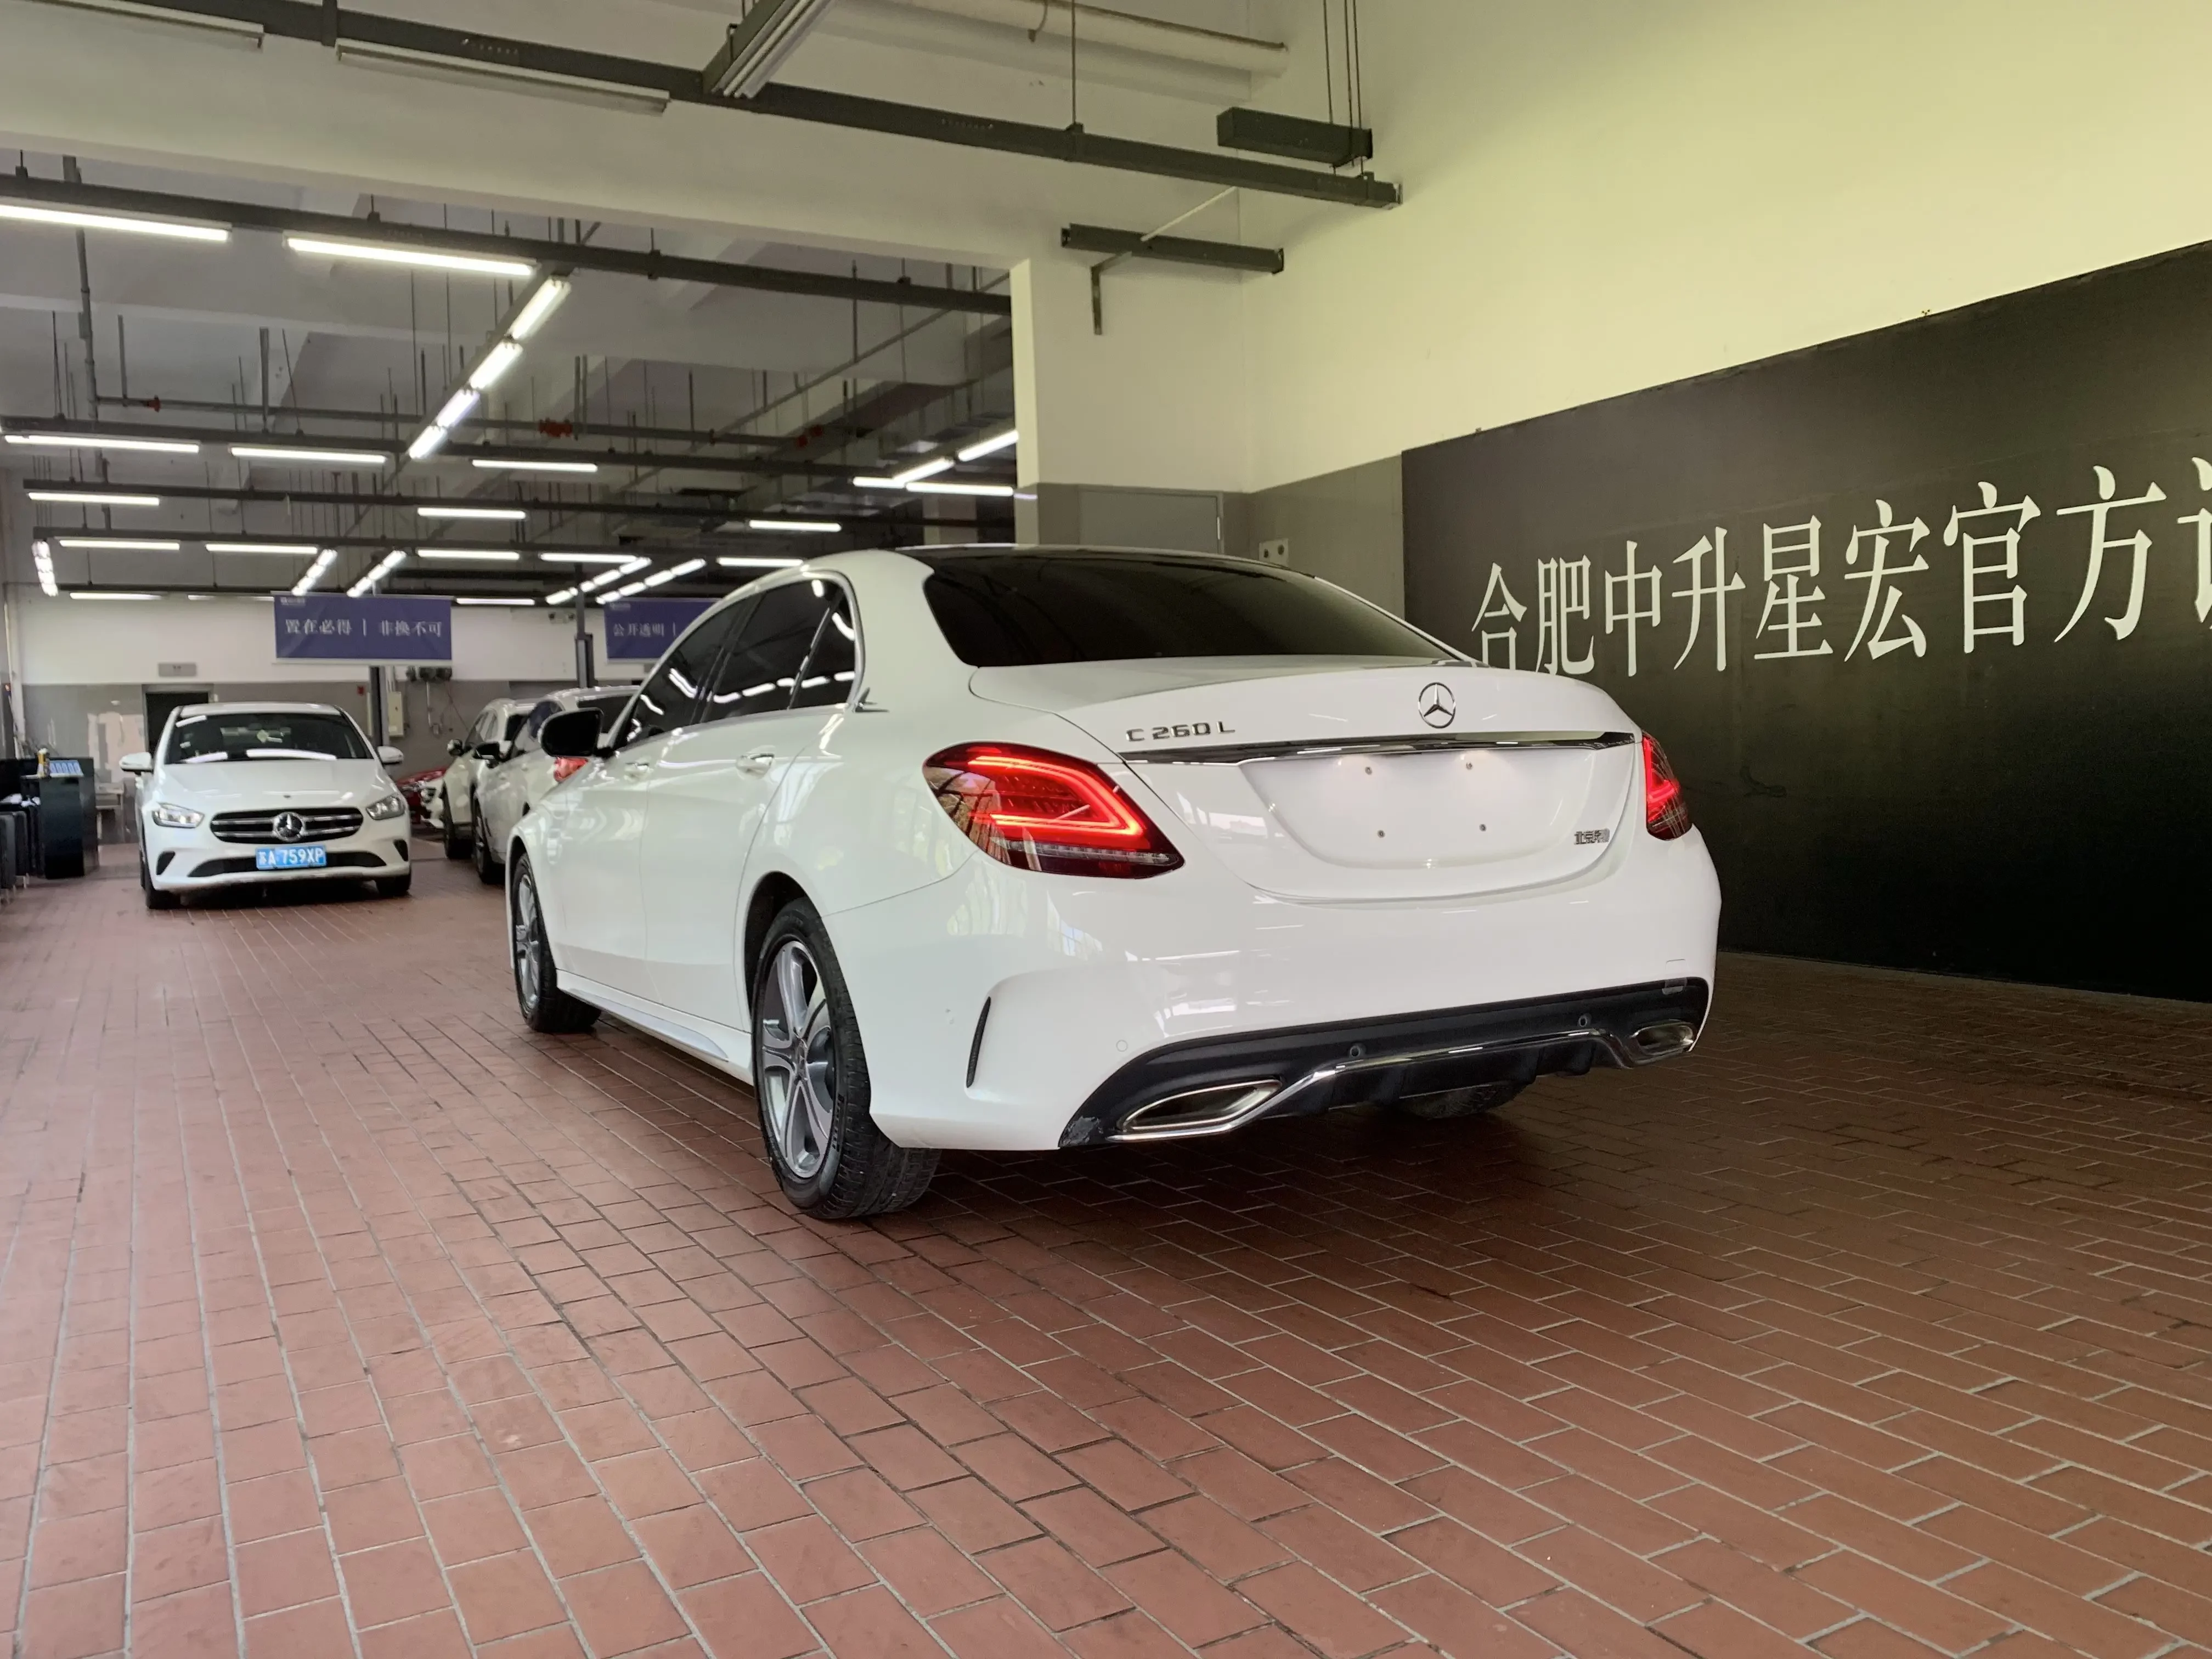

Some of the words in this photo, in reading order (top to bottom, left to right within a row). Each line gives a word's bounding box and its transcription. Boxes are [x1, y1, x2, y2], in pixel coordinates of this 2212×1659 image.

[1125, 728, 1145, 742] C
[1152, 723, 1211, 740] 260
[1216, 721, 1235, 734] L
